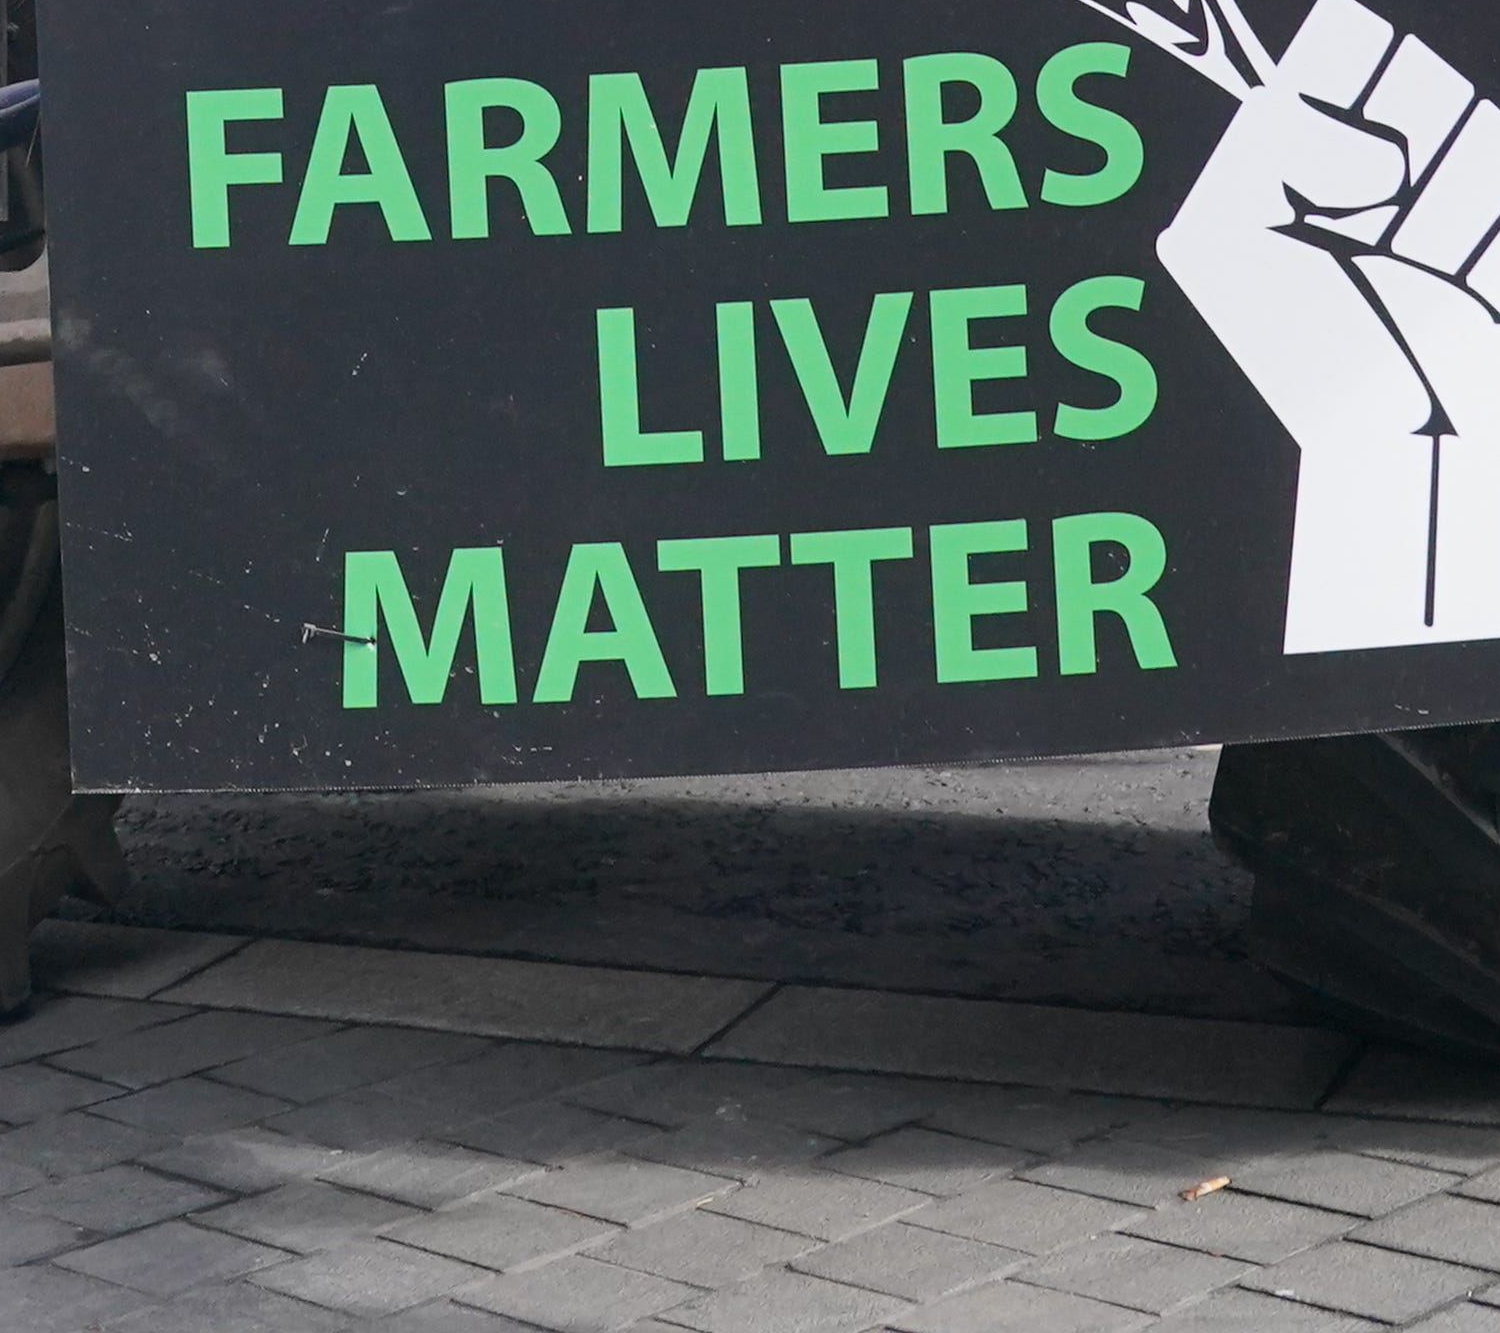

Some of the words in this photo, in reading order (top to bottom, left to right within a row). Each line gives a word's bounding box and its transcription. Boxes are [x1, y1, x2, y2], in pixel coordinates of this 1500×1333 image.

[187, 43, 1143, 247] FARMERS
[598, 276, 1157, 466] LIVES
[344, 513, 1176, 707] MATTER
